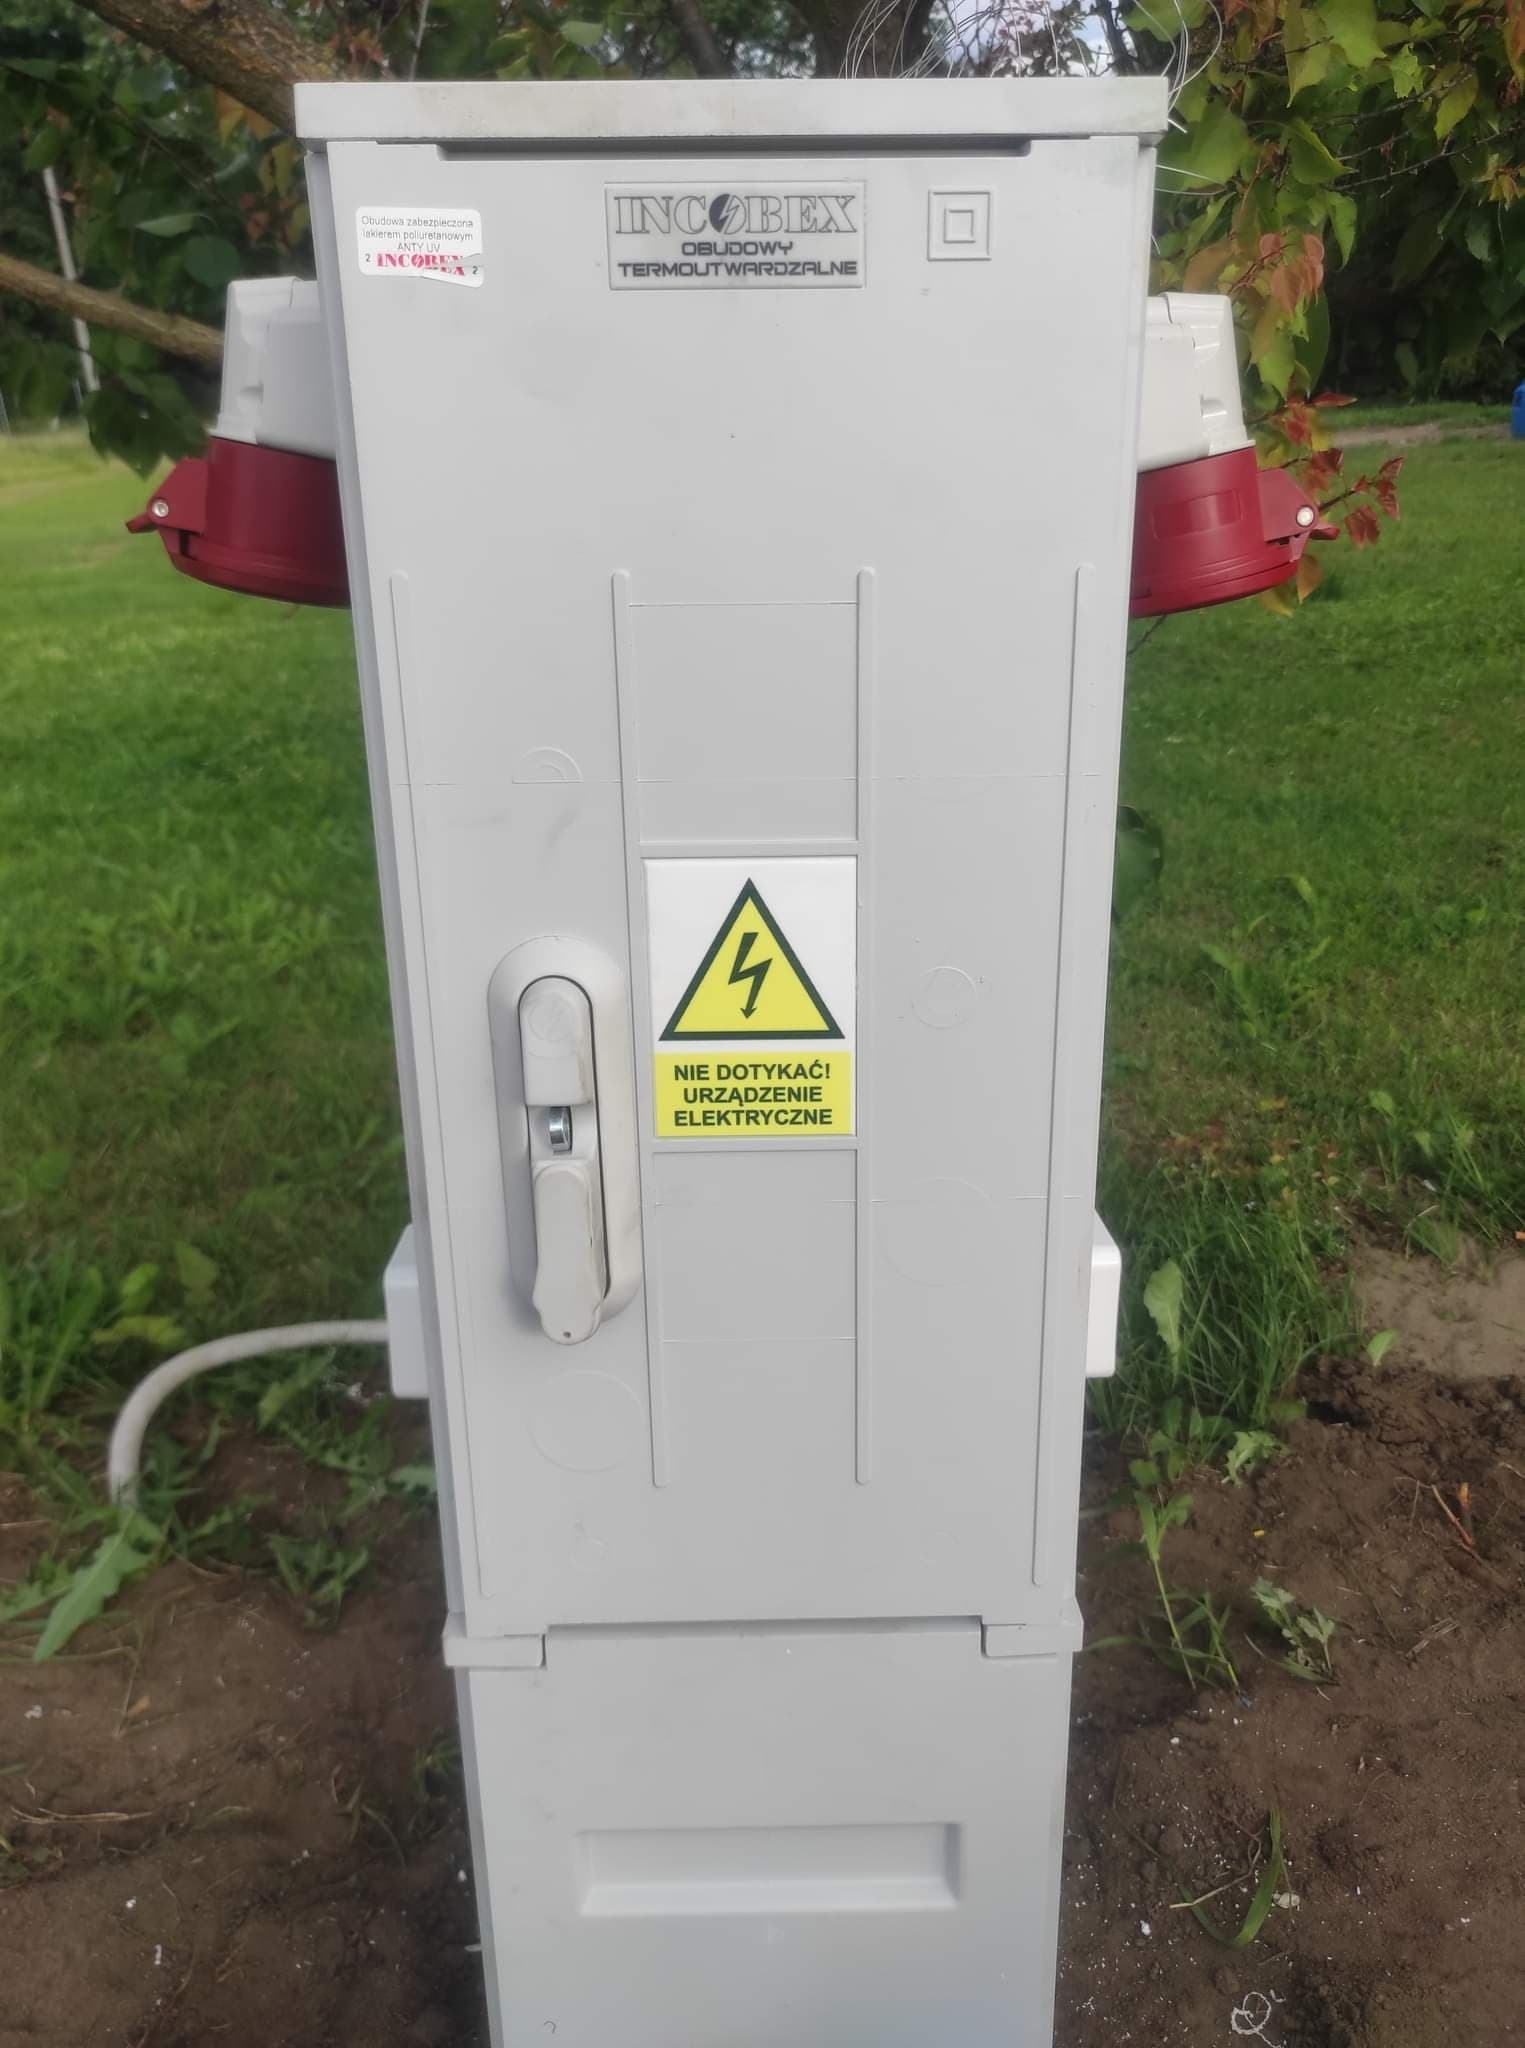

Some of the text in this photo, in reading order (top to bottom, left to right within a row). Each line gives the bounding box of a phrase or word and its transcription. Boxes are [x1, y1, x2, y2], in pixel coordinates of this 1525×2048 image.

[361, 215, 474, 229] Obudowa zabezpieczona
[613, 193, 858, 235] INCOBEX
[363, 229, 473, 243] lakierem poliuretanowym
[397, 242, 441, 253] ANTY UV
[680, 241, 794, 257] OBUDOWY
[617, 260, 858, 277] TERMOUTWARDZALNE
[674, 1059, 831, 1081] NIE DOTYKAĆ!
[683, 1086, 823, 1107] URZĄDZENIE
[674, 1108, 833, 1126] ELEKTRYCZNE
